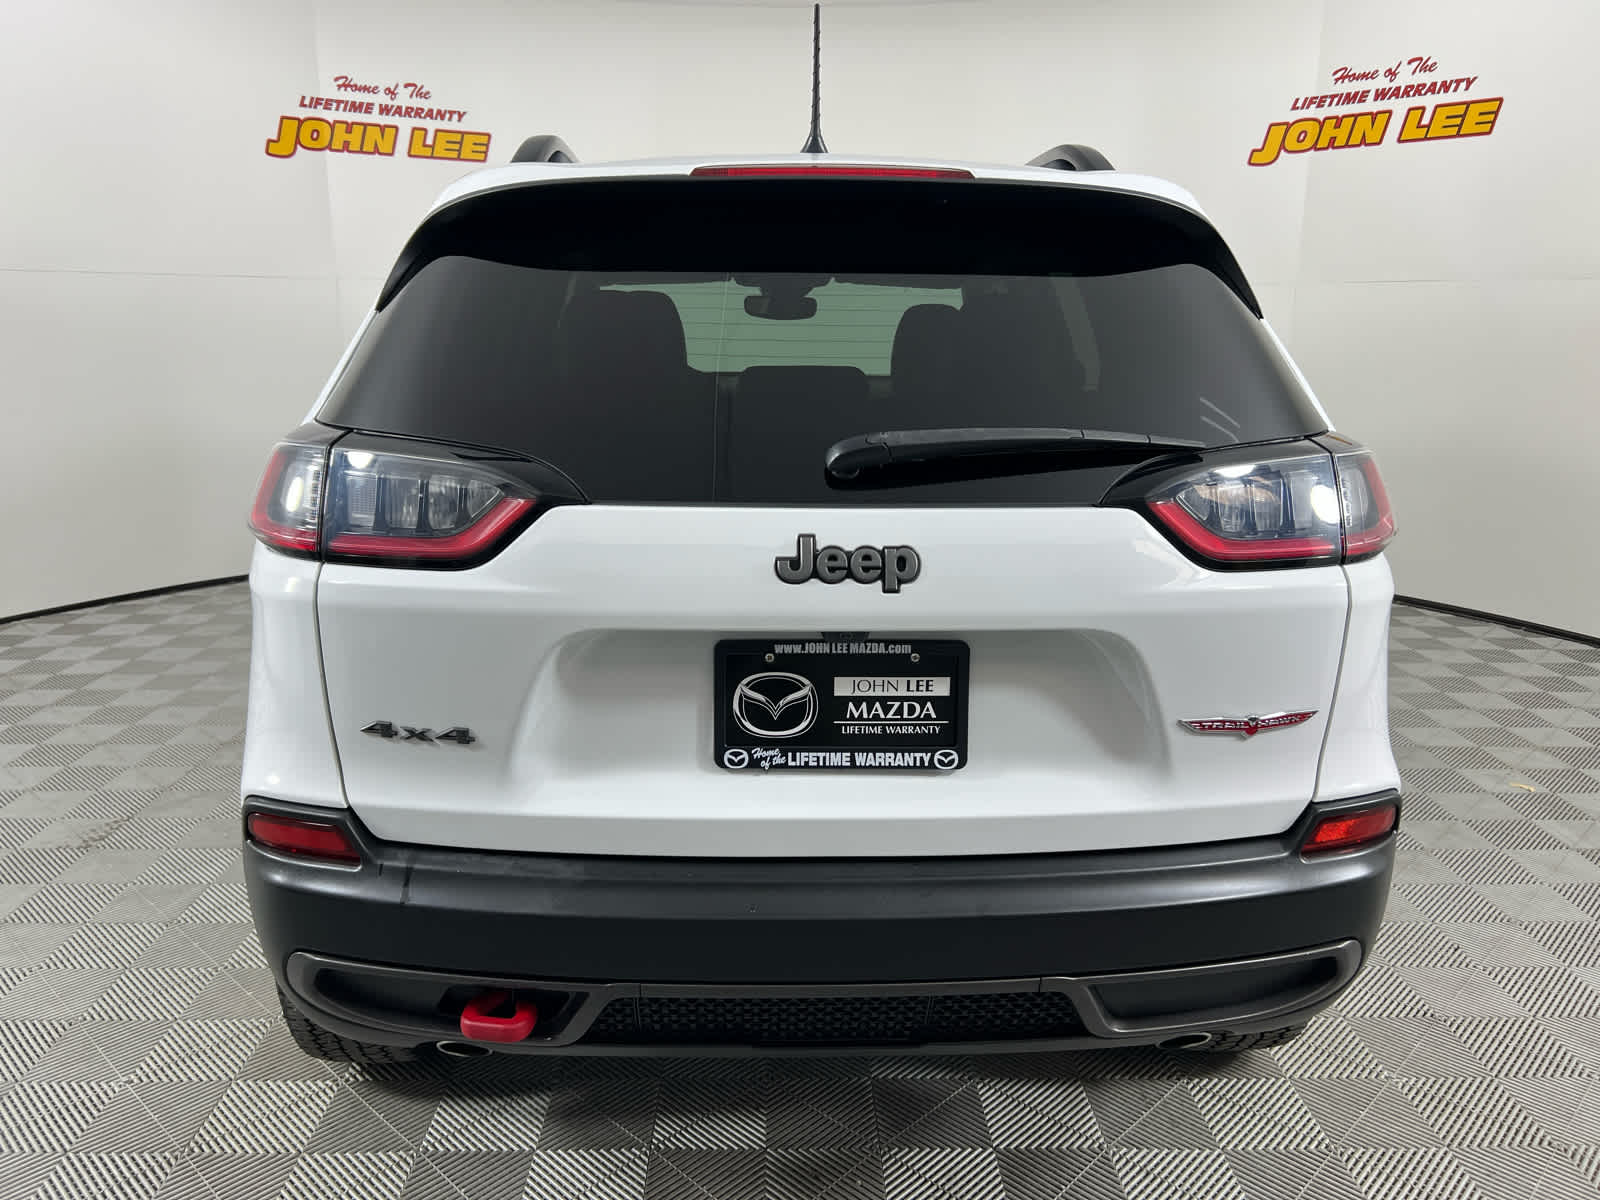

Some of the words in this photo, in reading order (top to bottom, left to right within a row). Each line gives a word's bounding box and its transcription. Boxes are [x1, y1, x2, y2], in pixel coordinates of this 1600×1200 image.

[1332, 66, 1379, 85] Home
[1384, 61, 1402, 82] of
[1407, 56, 1438, 76] The
[333, 75, 380, 94] Home
[384, 83, 399, 100] of
[404, 82, 431, 100] The
[1290, 88, 1370, 111] LIFETIME
[1373, 76, 1478, 102] WARRANTY
[299, 95, 374, 115] LIFETIME
[379, 103, 466, 122] WARRANTY
[265, 115, 399, 159] JOHN
[407, 127, 491, 163] LEE
[1248, 109, 1392, 167] JOHN
[1397, 96, 1504, 143] LEE
[774, 533, 922, 593] Jeep
[831, 642, 848, 654] LEE
[852, 679, 899, 694] JOHN
[906, 679, 934, 692] LEE
[846, 701, 937, 719] MAZDA
[360, 720, 476, 744] 4x4
[841, 725, 883, 735] LIFETIME
[885, 725, 941, 735] WARRANTY
[752, 747, 779, 759] Home
[760, 757, 771, 770] of
[772, 754, 786, 766] the
[787, 752, 851, 766] LIFETIME
[854, 752, 932, 766] WARRANTY
